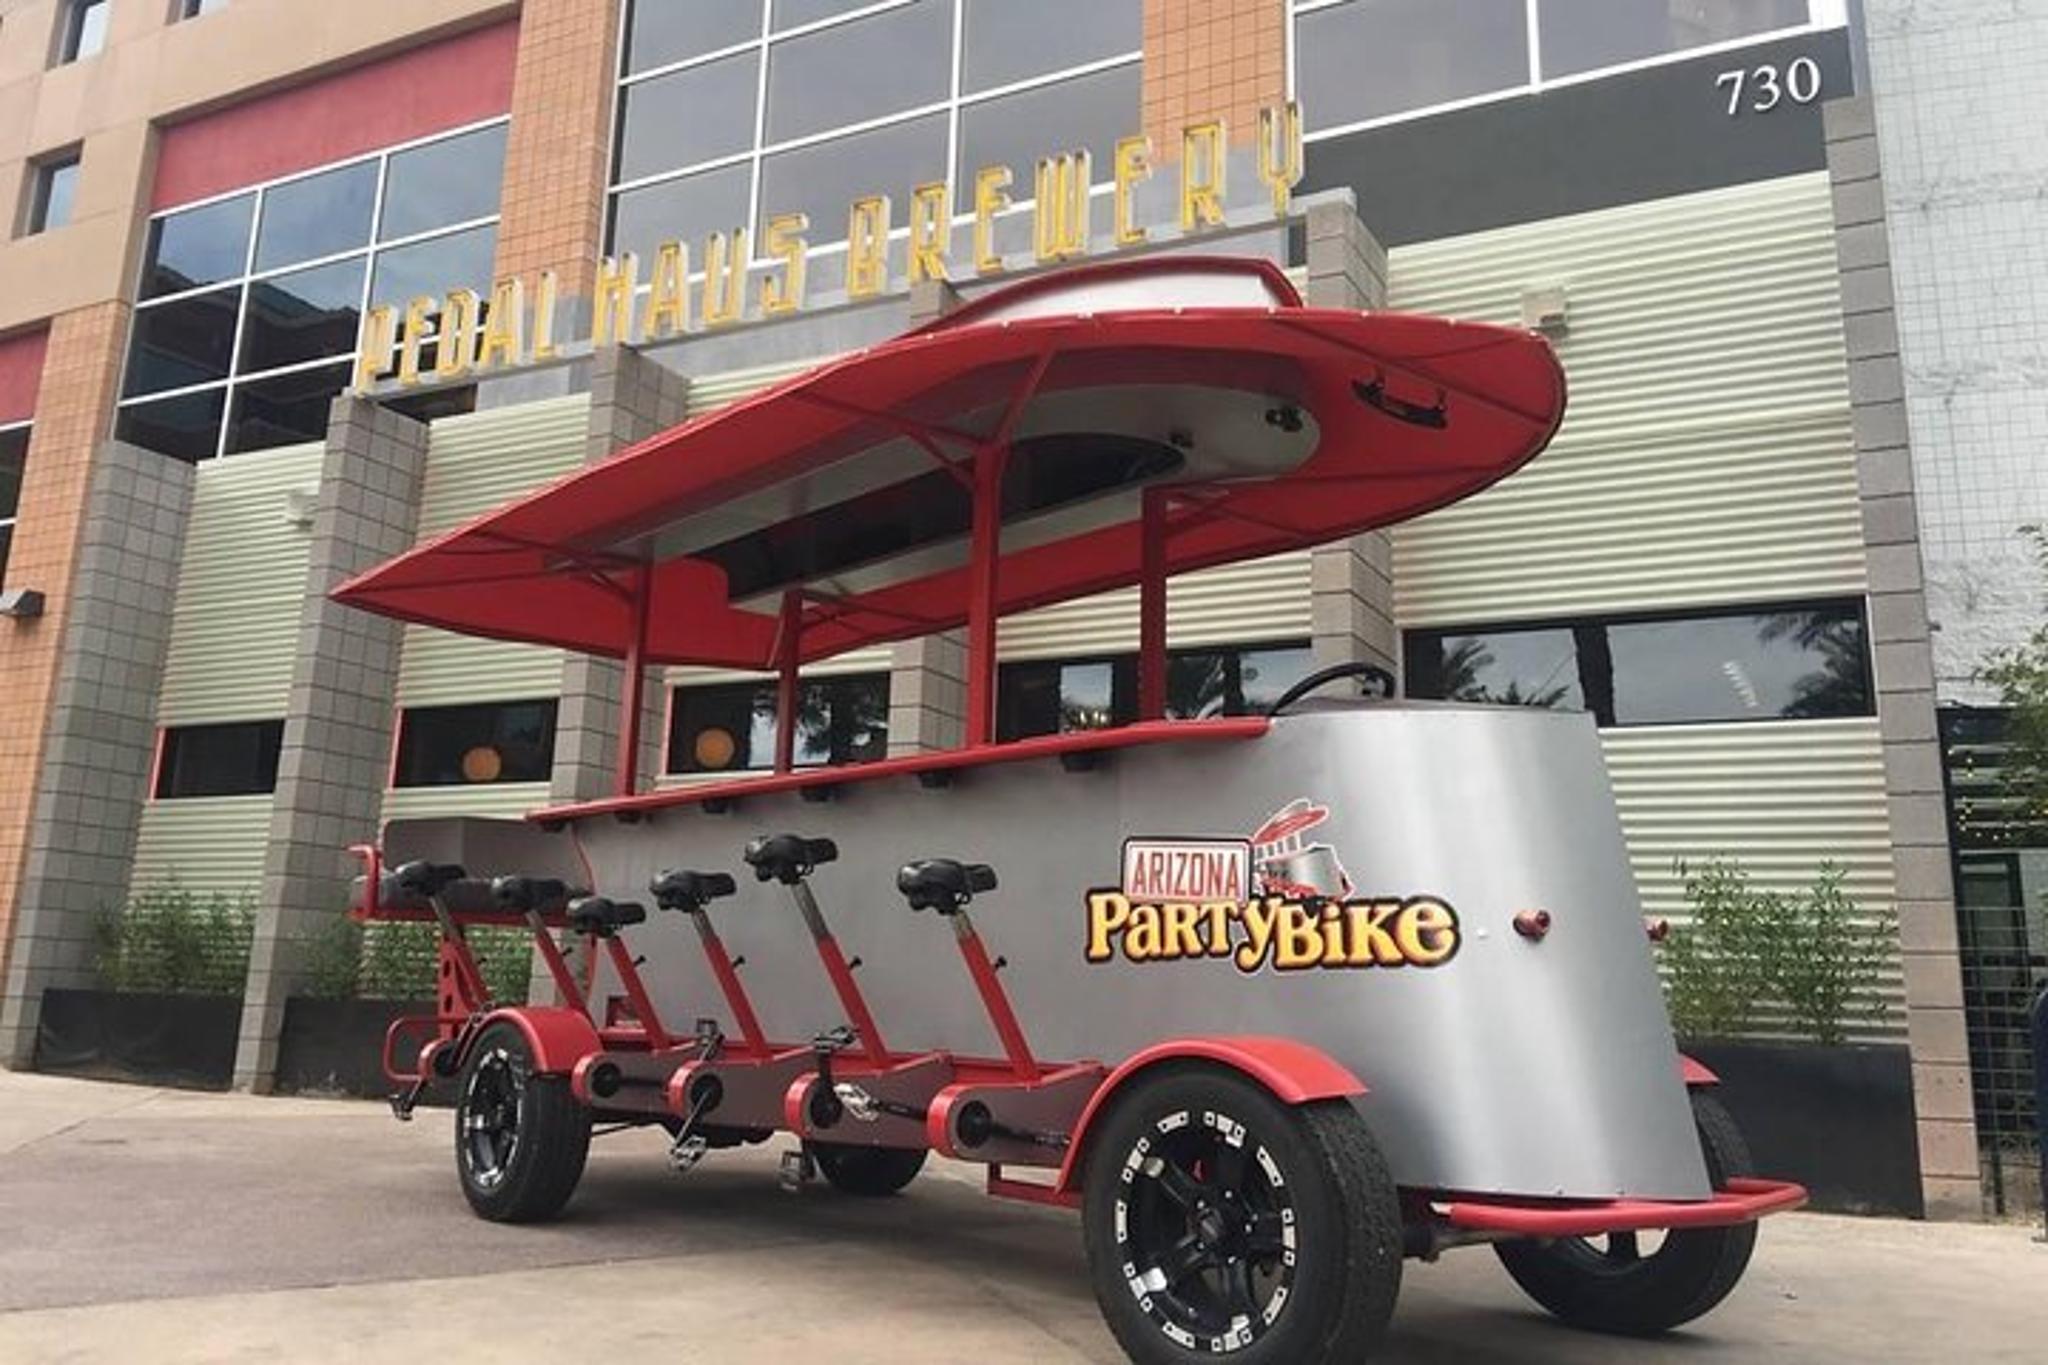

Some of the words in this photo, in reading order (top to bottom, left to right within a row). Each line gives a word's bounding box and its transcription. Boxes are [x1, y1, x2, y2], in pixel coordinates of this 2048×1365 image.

[1715, 56, 1821, 115] 730
[354, 271, 560, 397] PEDAL
[593, 213, 809, 347] HAUS
[847, 101, 1304, 297] BREWERY
[1131, 851, 1241, 898] ARIZONA
